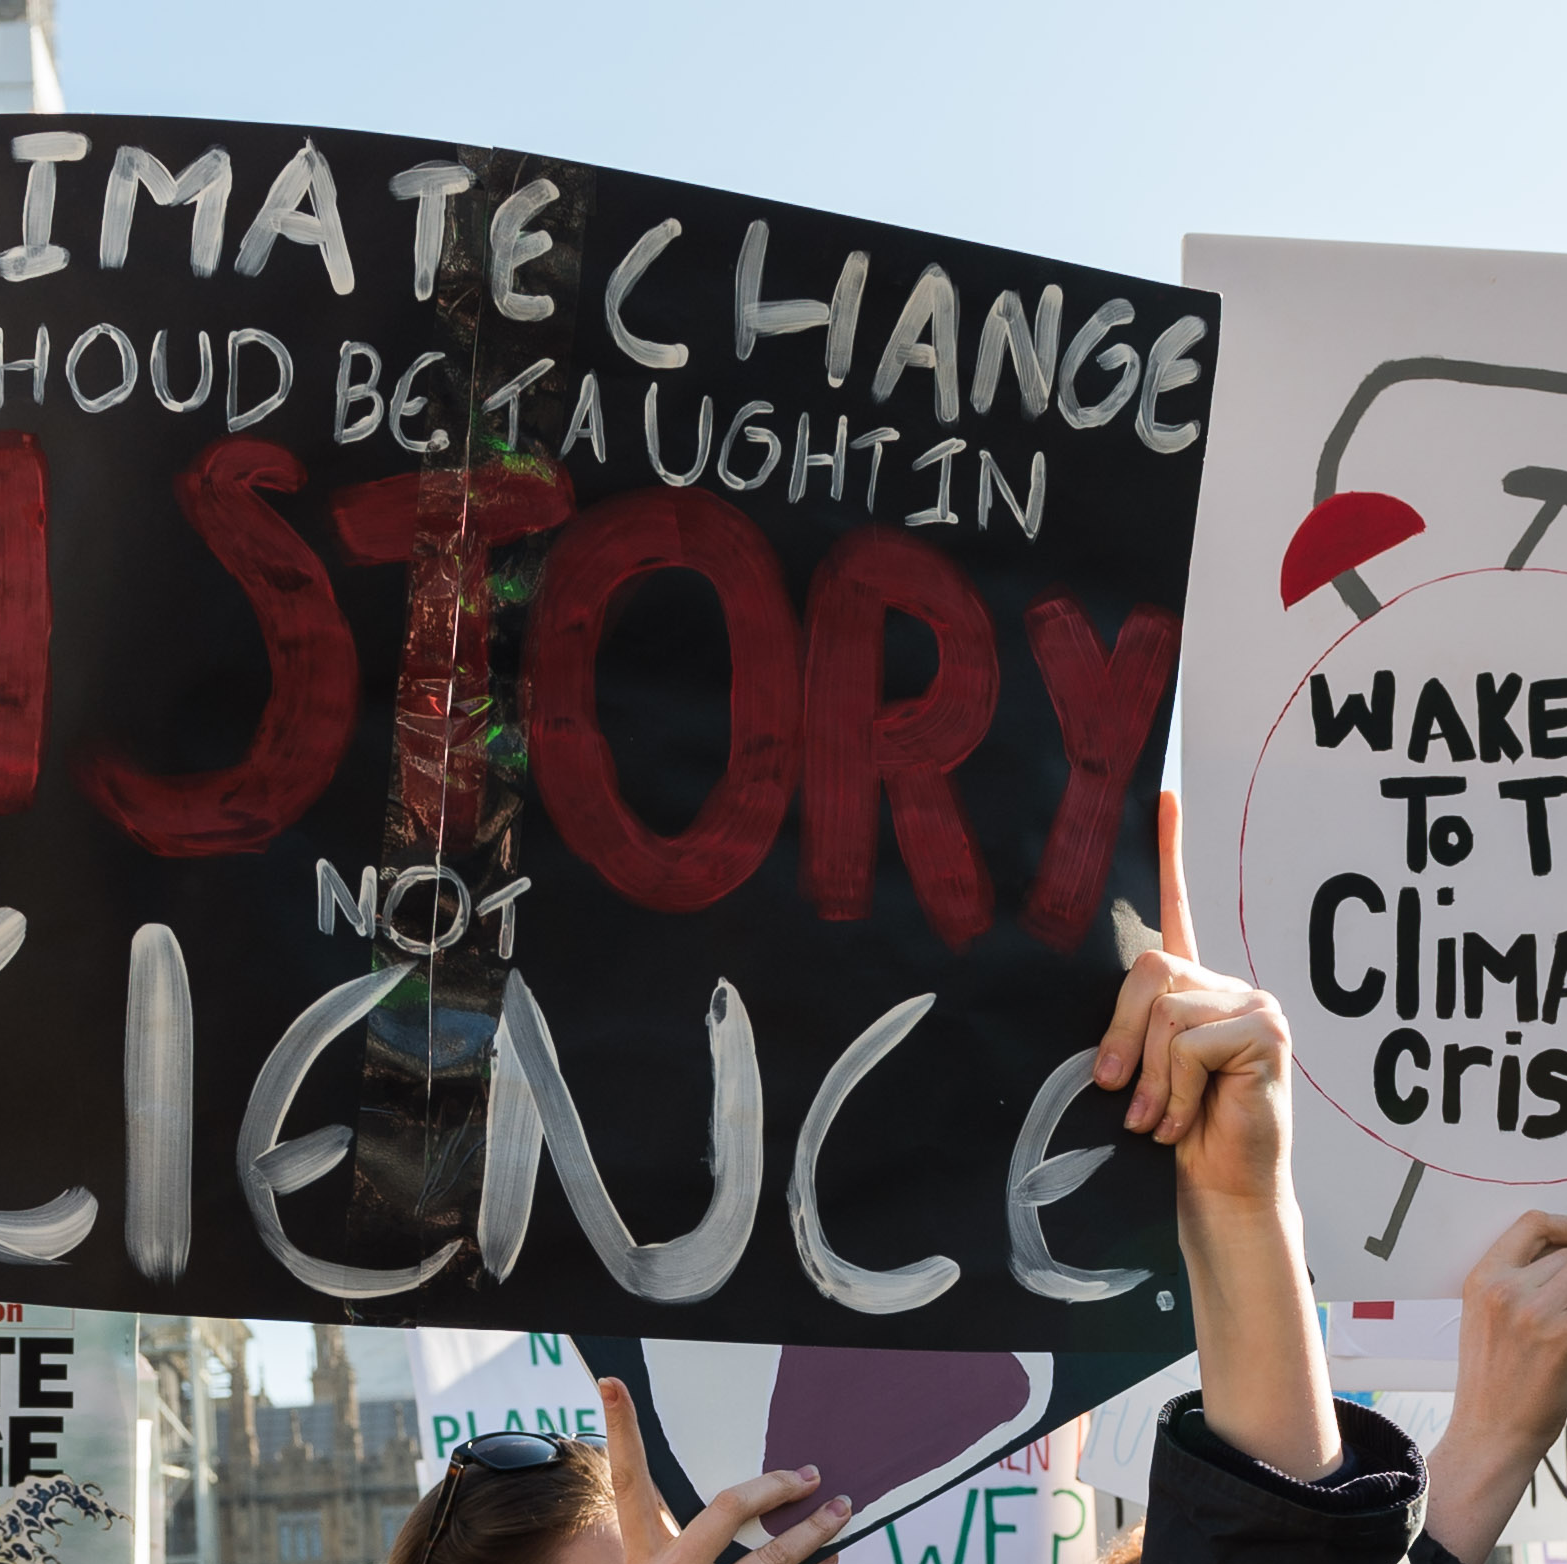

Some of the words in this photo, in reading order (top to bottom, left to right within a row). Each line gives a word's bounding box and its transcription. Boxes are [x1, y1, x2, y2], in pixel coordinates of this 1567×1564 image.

[605, 218, 1208, 453] CHANGE
[334, 341, 450, 454] BE
[904, 437, 1047, 540] IN
[315, 856, 532, 960] NOT
